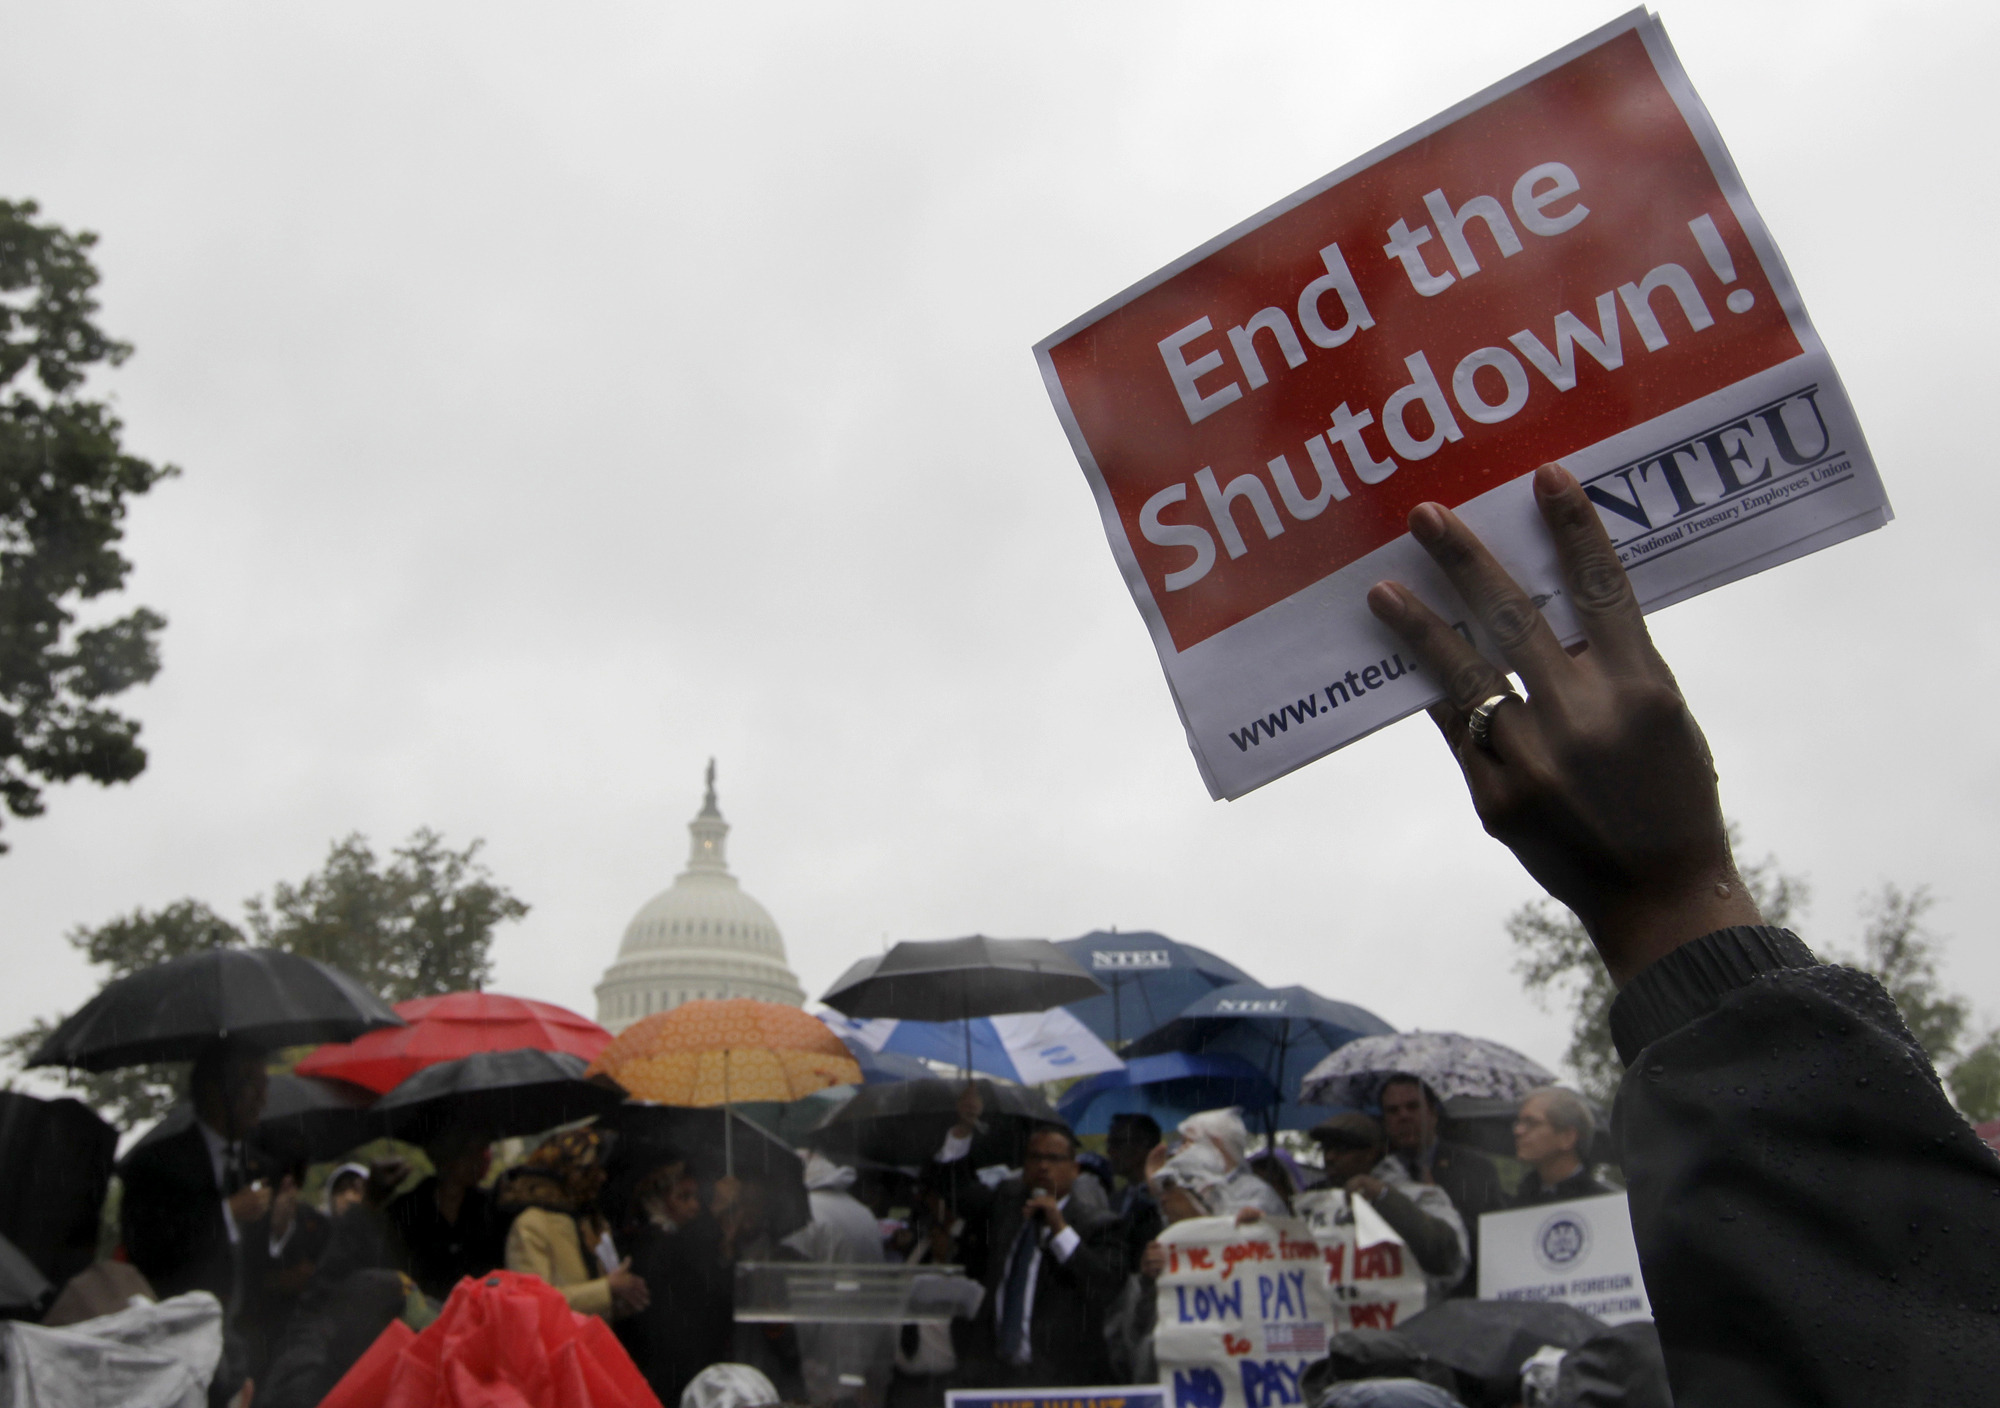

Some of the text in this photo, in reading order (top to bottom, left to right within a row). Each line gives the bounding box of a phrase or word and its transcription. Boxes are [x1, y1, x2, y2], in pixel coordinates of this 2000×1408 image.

[1157, 162, 1591, 424] End the
[1139, 213, 1755, 592] Shutdown!
[1583, 389, 1830, 543] NTEU
[1630, 527, 1684, 558] National
[1683, 505, 1740, 535] Treasury
[1740, 476, 1809, 511] Employees
[1810, 460, 1851, 482] Union
[1228, 620, 1477, 753] www.nteu.
[1092, 950, 1171, 968] NTEU
[1175, 1268, 1308, 1323] LOW PAY
[1222, 1333, 1253, 1356] to
[1173, 1358, 1310, 1408] NO PAY
